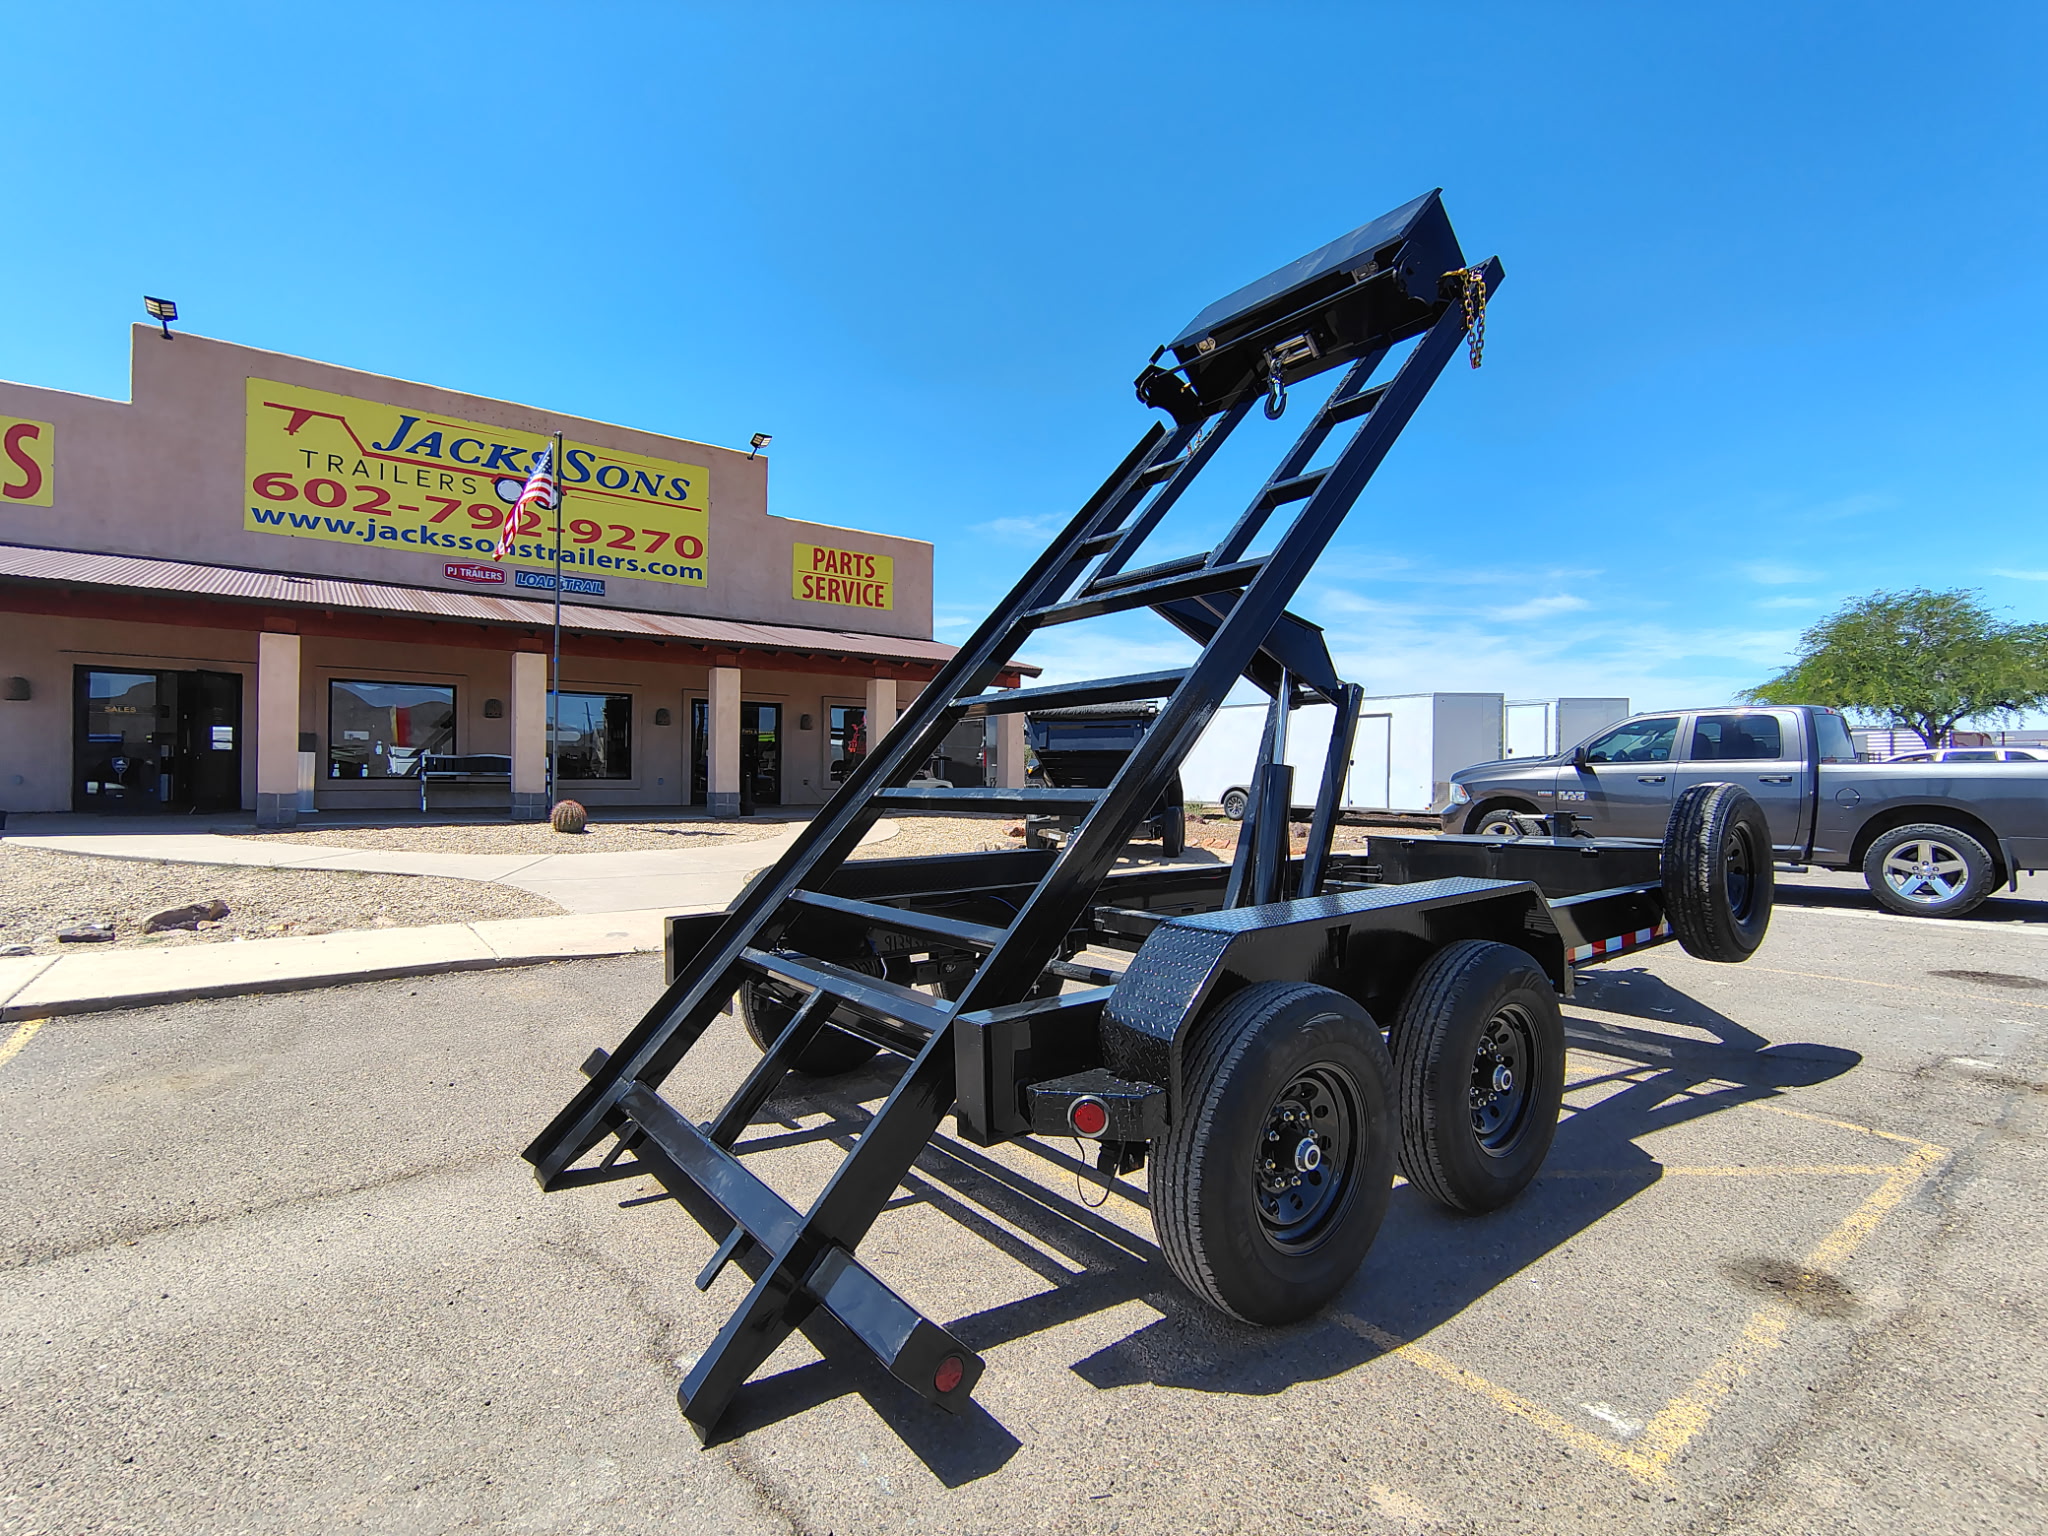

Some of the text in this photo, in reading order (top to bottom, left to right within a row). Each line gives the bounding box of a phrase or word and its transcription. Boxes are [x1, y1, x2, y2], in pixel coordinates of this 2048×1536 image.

[2, 423, 42, 499] S
[299, 448, 477, 495] TRAILERS
[252, 471, 704, 560] 602-792-9270
[447, 566, 503, 581] PJ TRAILERS
[813, 547, 876, 579] PARTS
[515, 572, 605, 594] LOAD TRAIL
[802, 574, 885, 608] SERVICE
[104, 705, 137, 713] SALES
